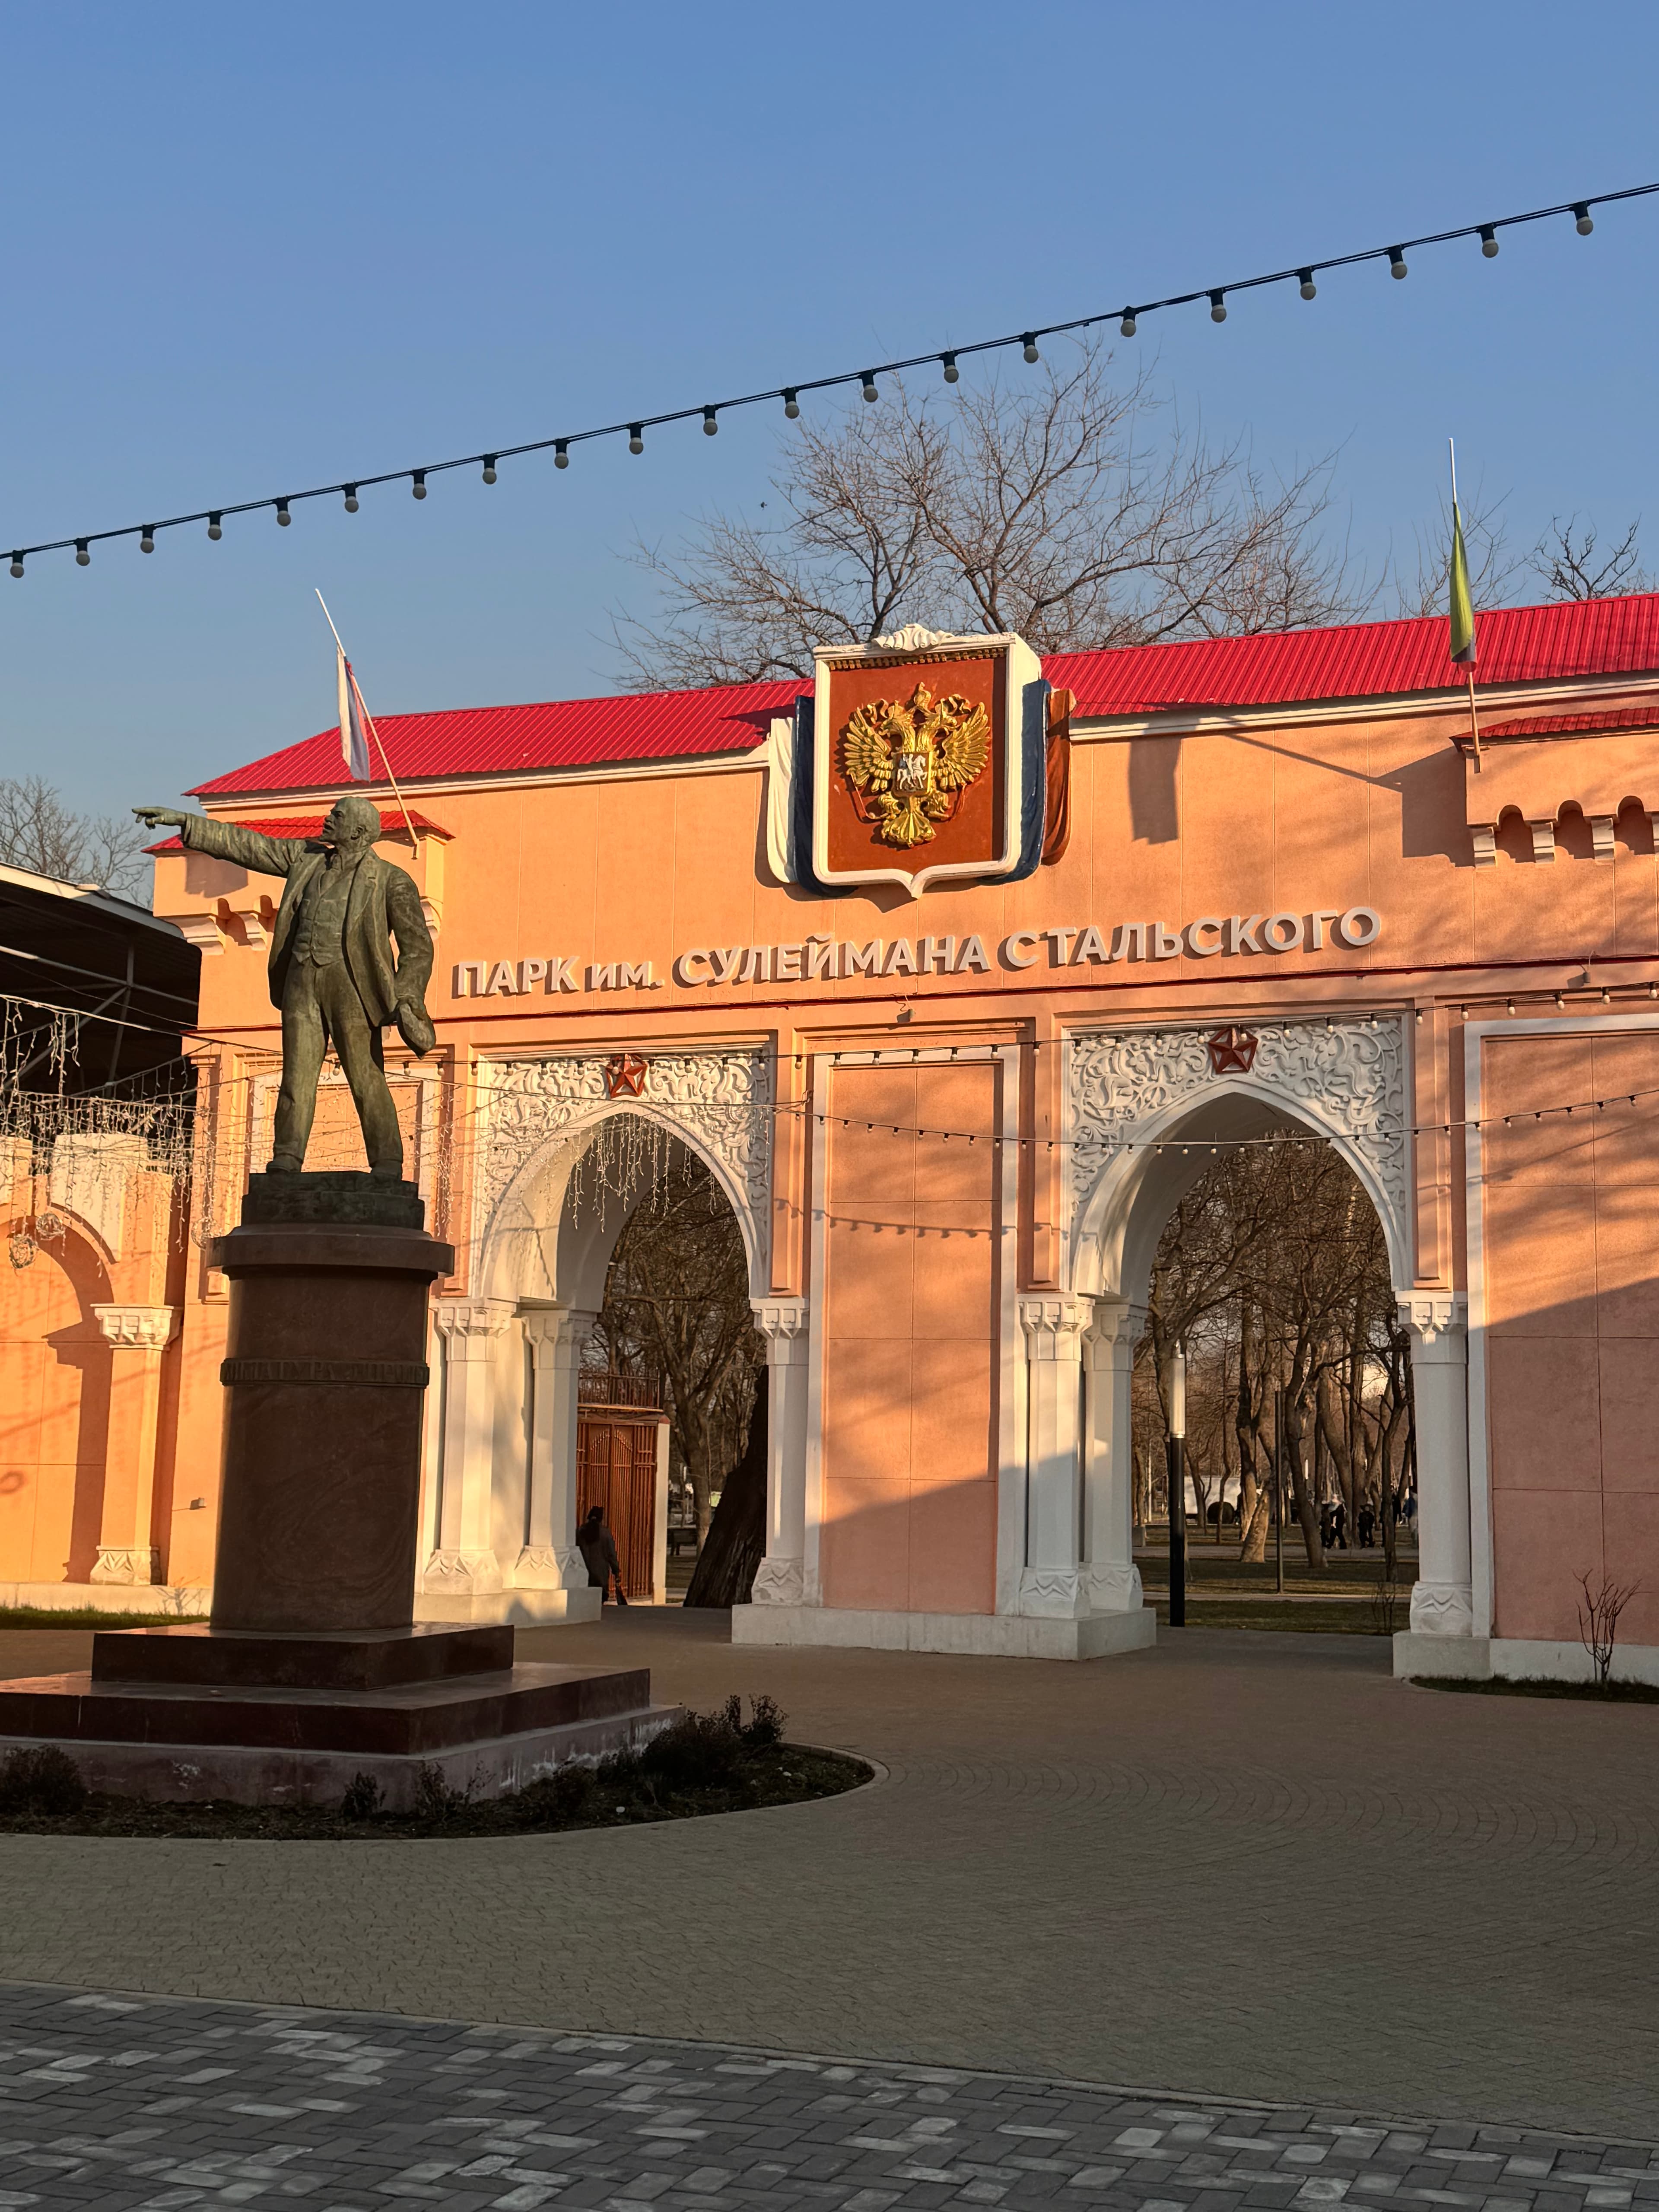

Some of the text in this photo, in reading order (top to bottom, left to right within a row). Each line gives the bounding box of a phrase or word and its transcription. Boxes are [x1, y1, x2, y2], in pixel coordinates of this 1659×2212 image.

[458, 955, 580, 996] ПАРК
[678, 931, 992, 985] СУЛЕЙМАНА
[1005, 906, 1382, 968] СТАЛЬСКОГО
